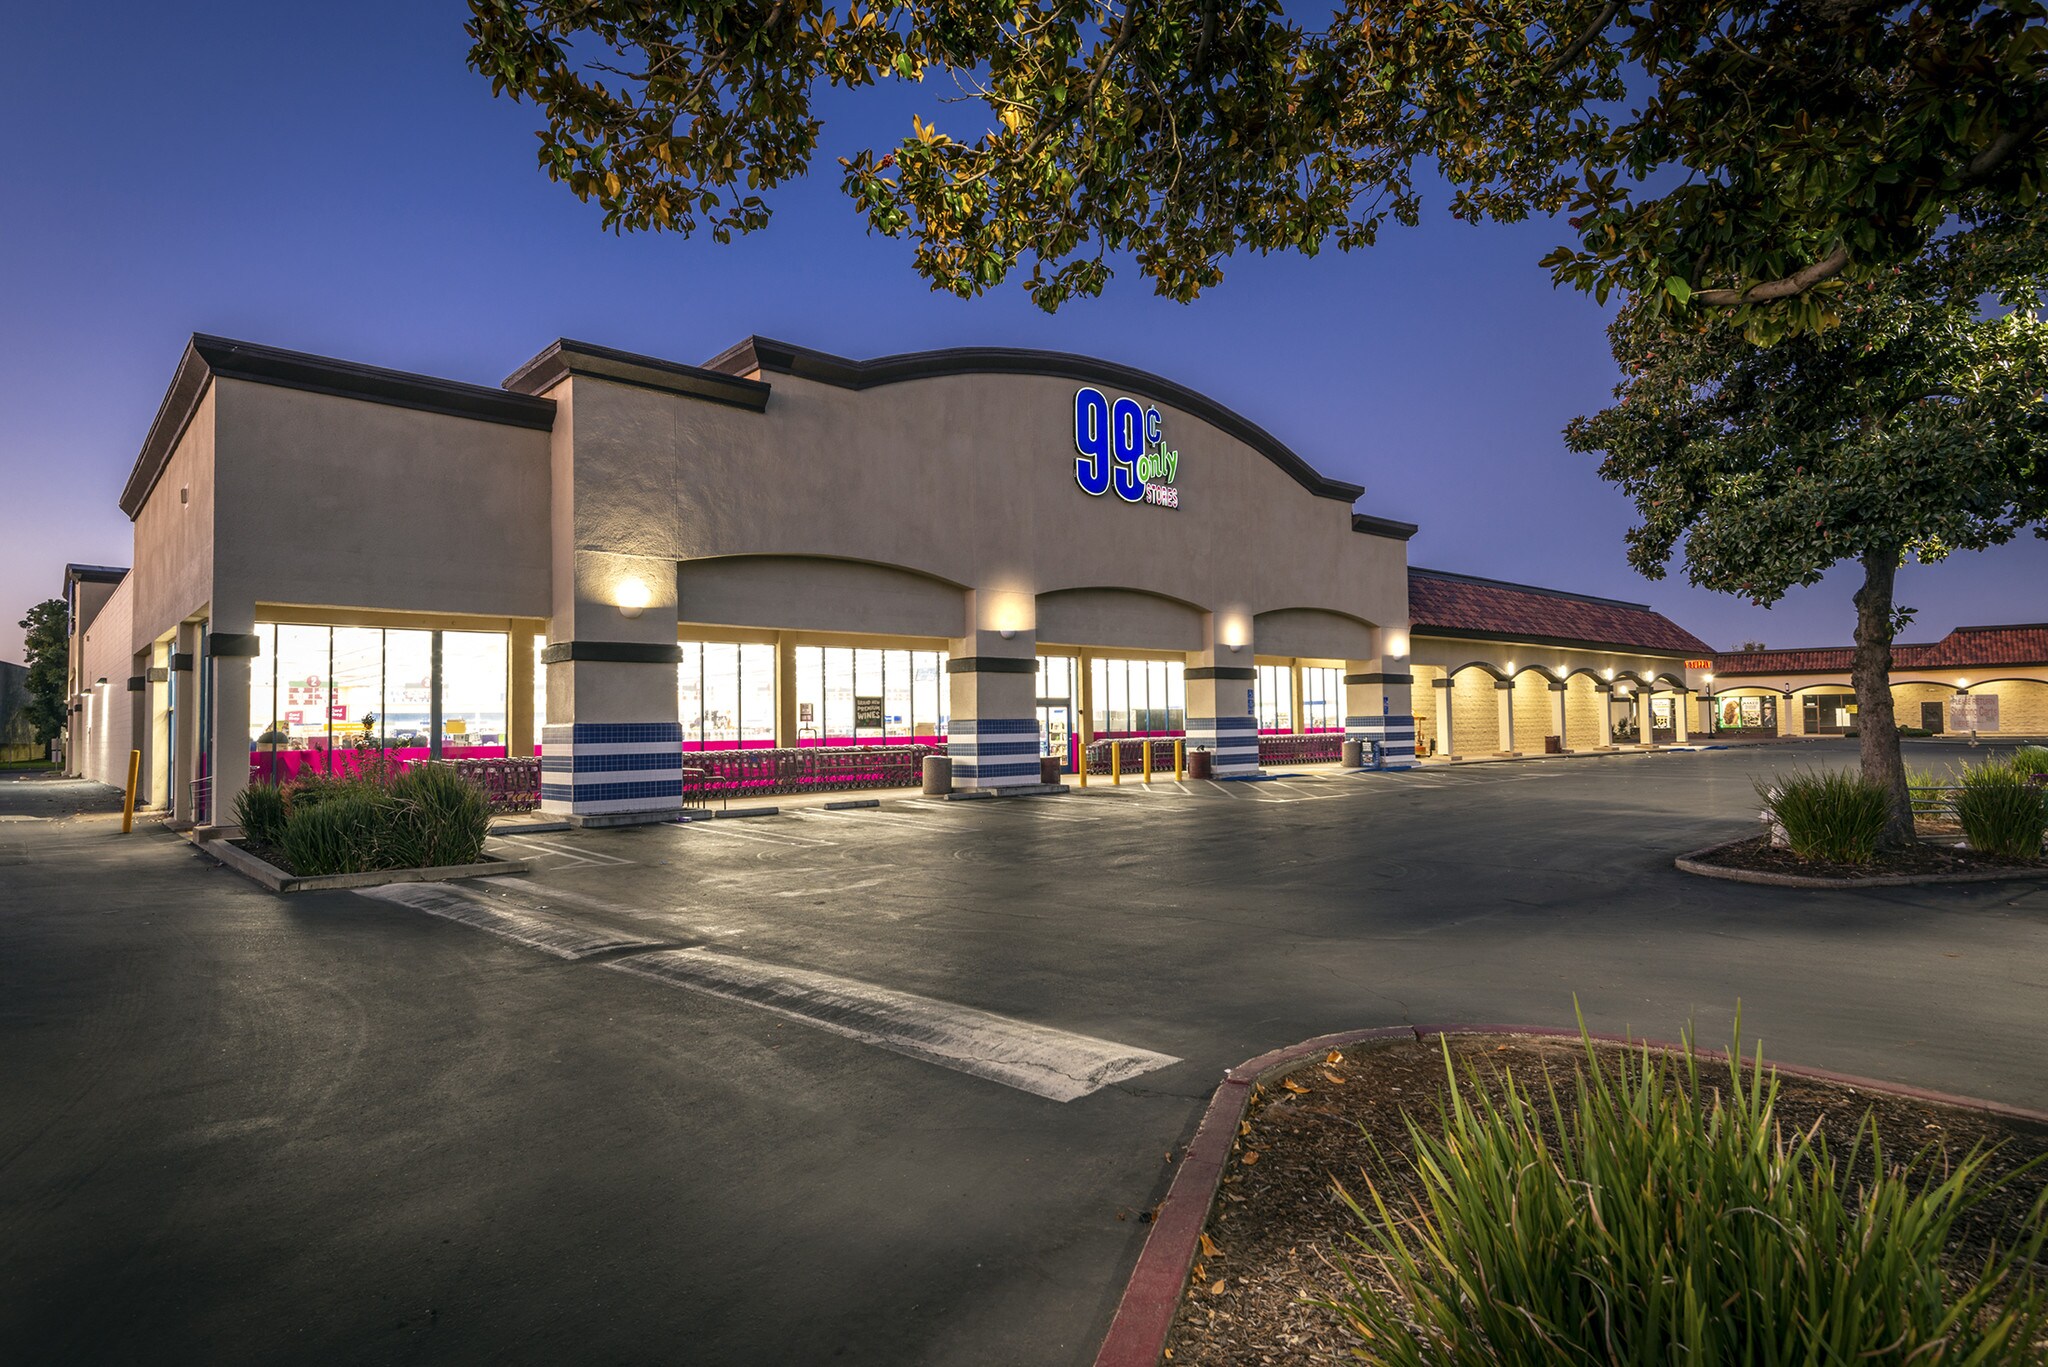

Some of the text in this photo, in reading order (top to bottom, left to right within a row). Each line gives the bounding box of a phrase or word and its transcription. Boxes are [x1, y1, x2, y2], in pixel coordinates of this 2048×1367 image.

[1137, 441, 1178, 484] only
[1146, 483, 1178, 508] STORES
[857, 711, 880, 720] WINES
